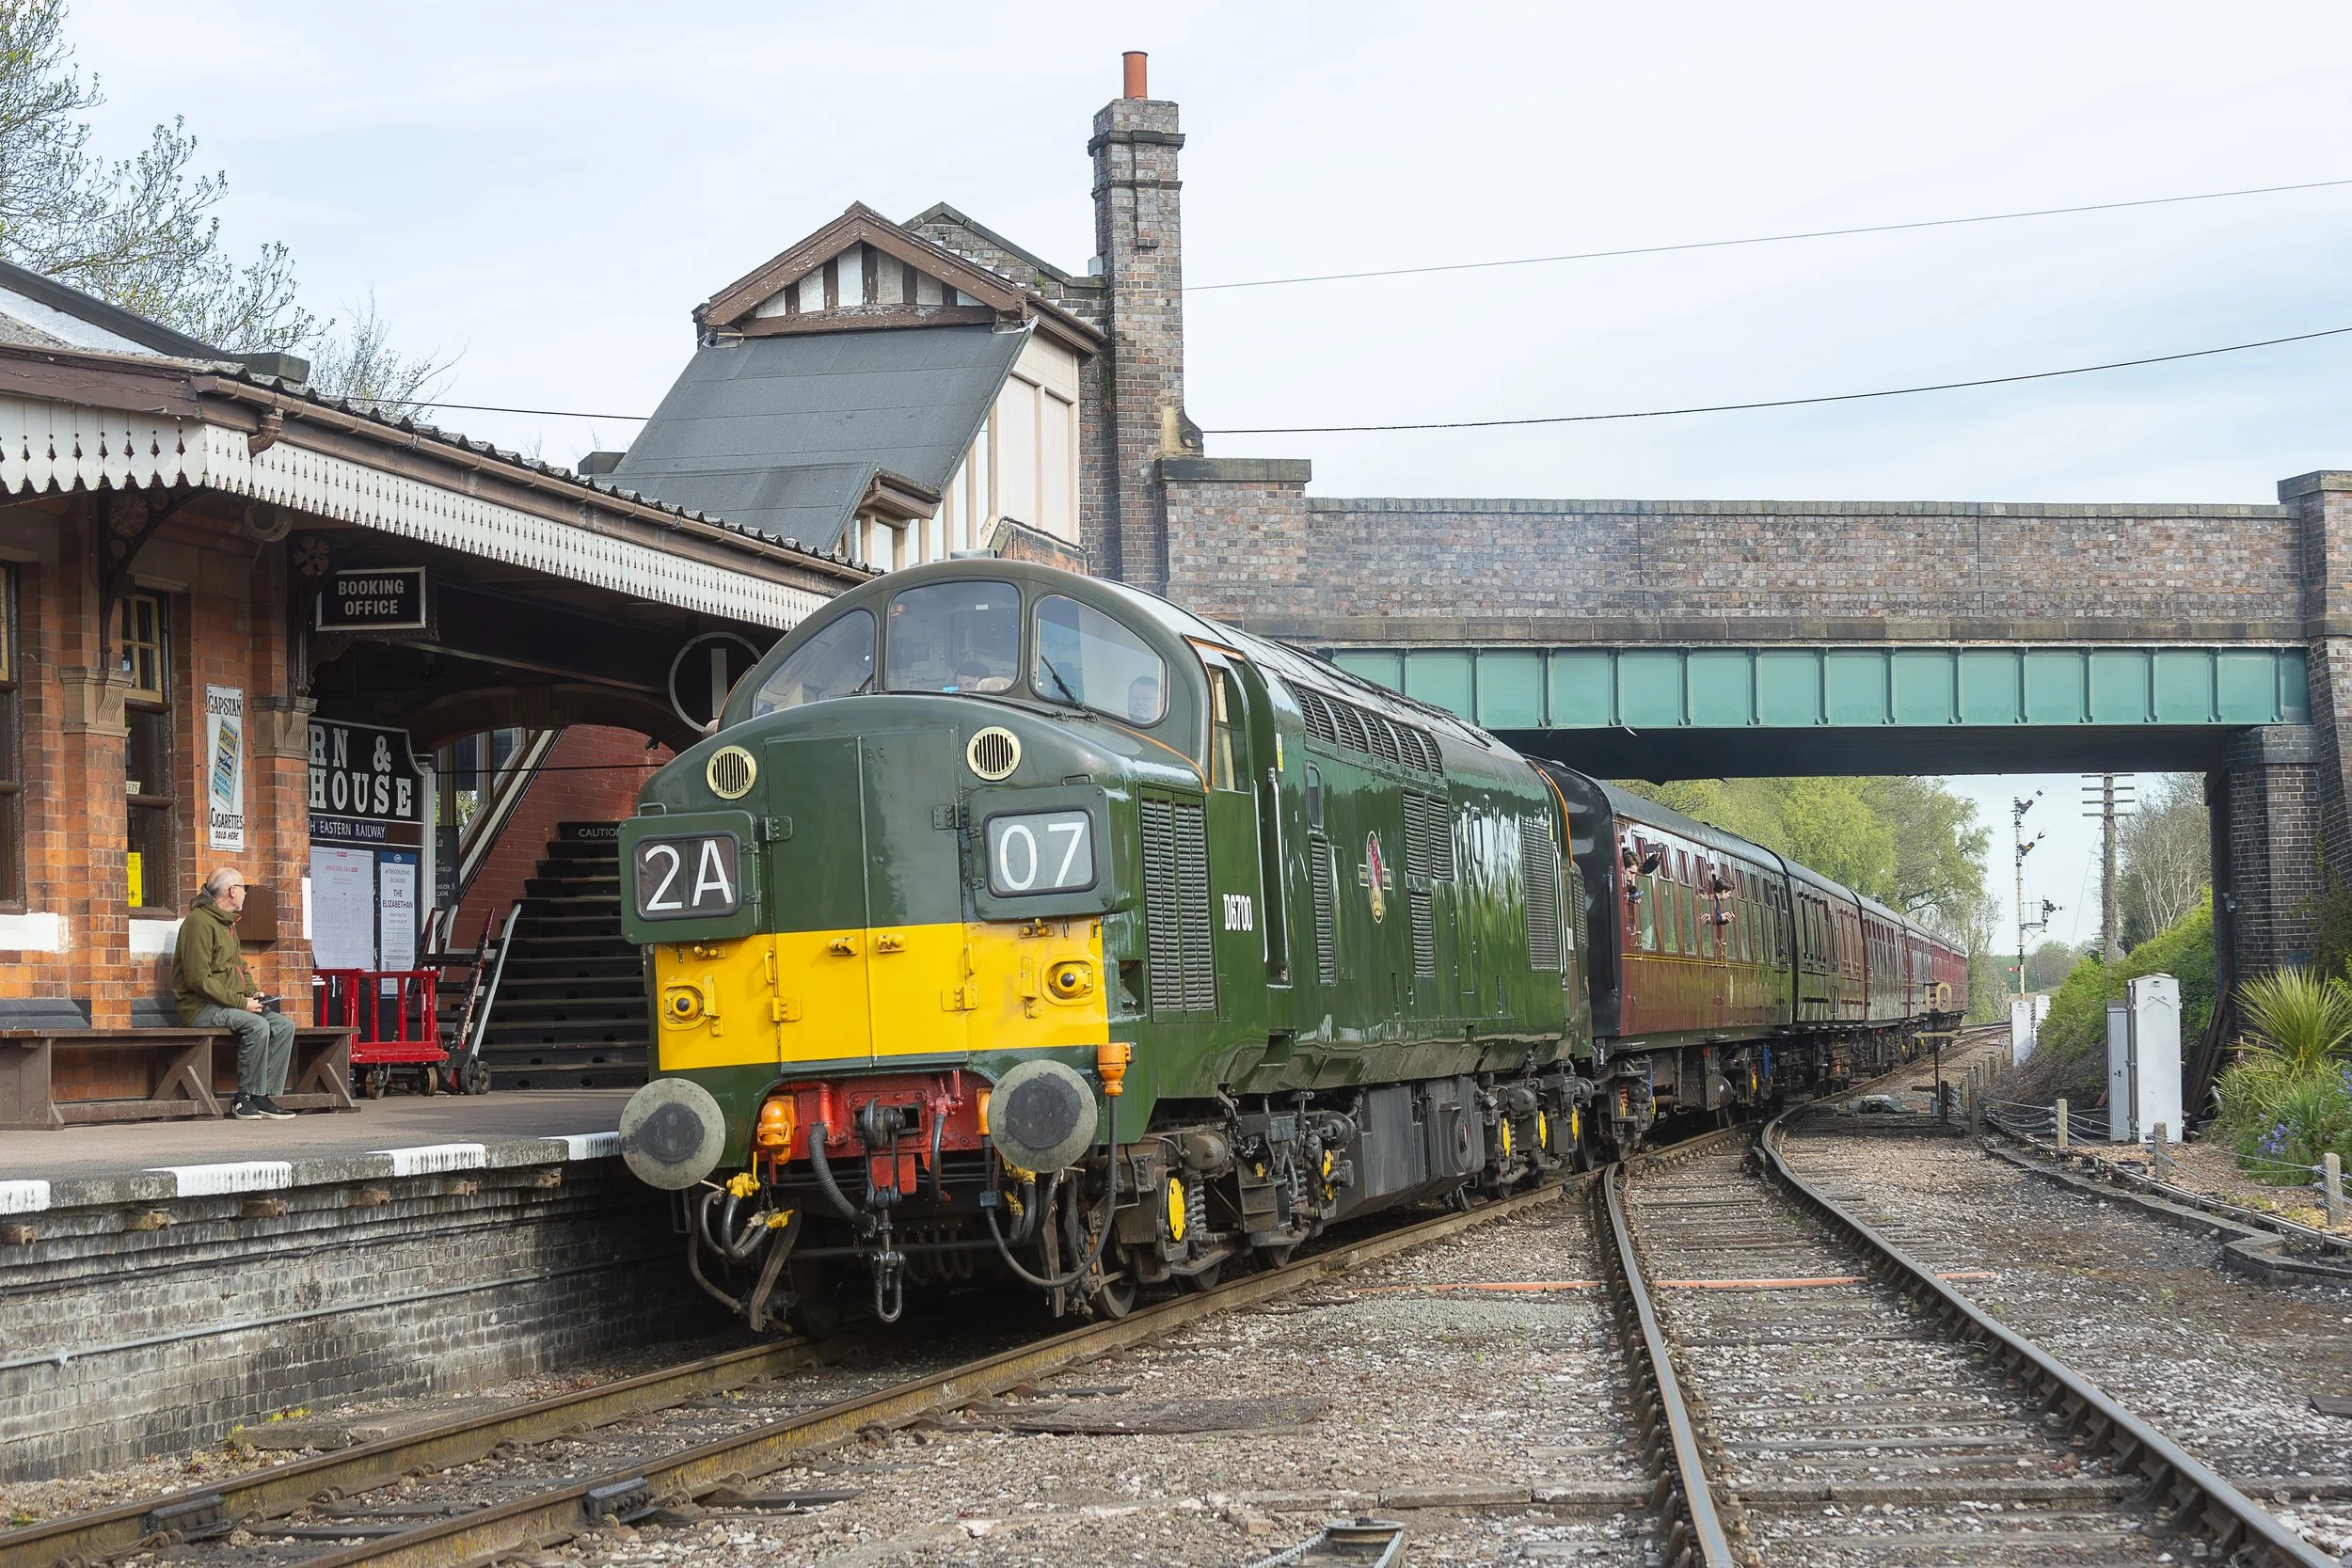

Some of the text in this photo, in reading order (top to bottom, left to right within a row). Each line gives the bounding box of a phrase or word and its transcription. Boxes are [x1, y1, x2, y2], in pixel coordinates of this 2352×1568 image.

[338, 579, 404, 595] BOOKING
[344, 599, 398, 616] OFFICE
[208, 695, 242, 718] CAPSTAN
[373, 735, 392, 772] &
[211, 807, 243, 830] CIGARETTES
[215, 831, 239, 841] SOLD HERE
[320, 820, 351, 835] EASTERN
[356, 823, 386, 839] RAILWAY
[999, 821, 1086, 891] 07
[645, 840, 734, 911] 2A
[393, 889, 403, 897] THE
[382, 899, 414, 909] ELIZABETHAN
[1223, 894, 1253, 931] D6700
